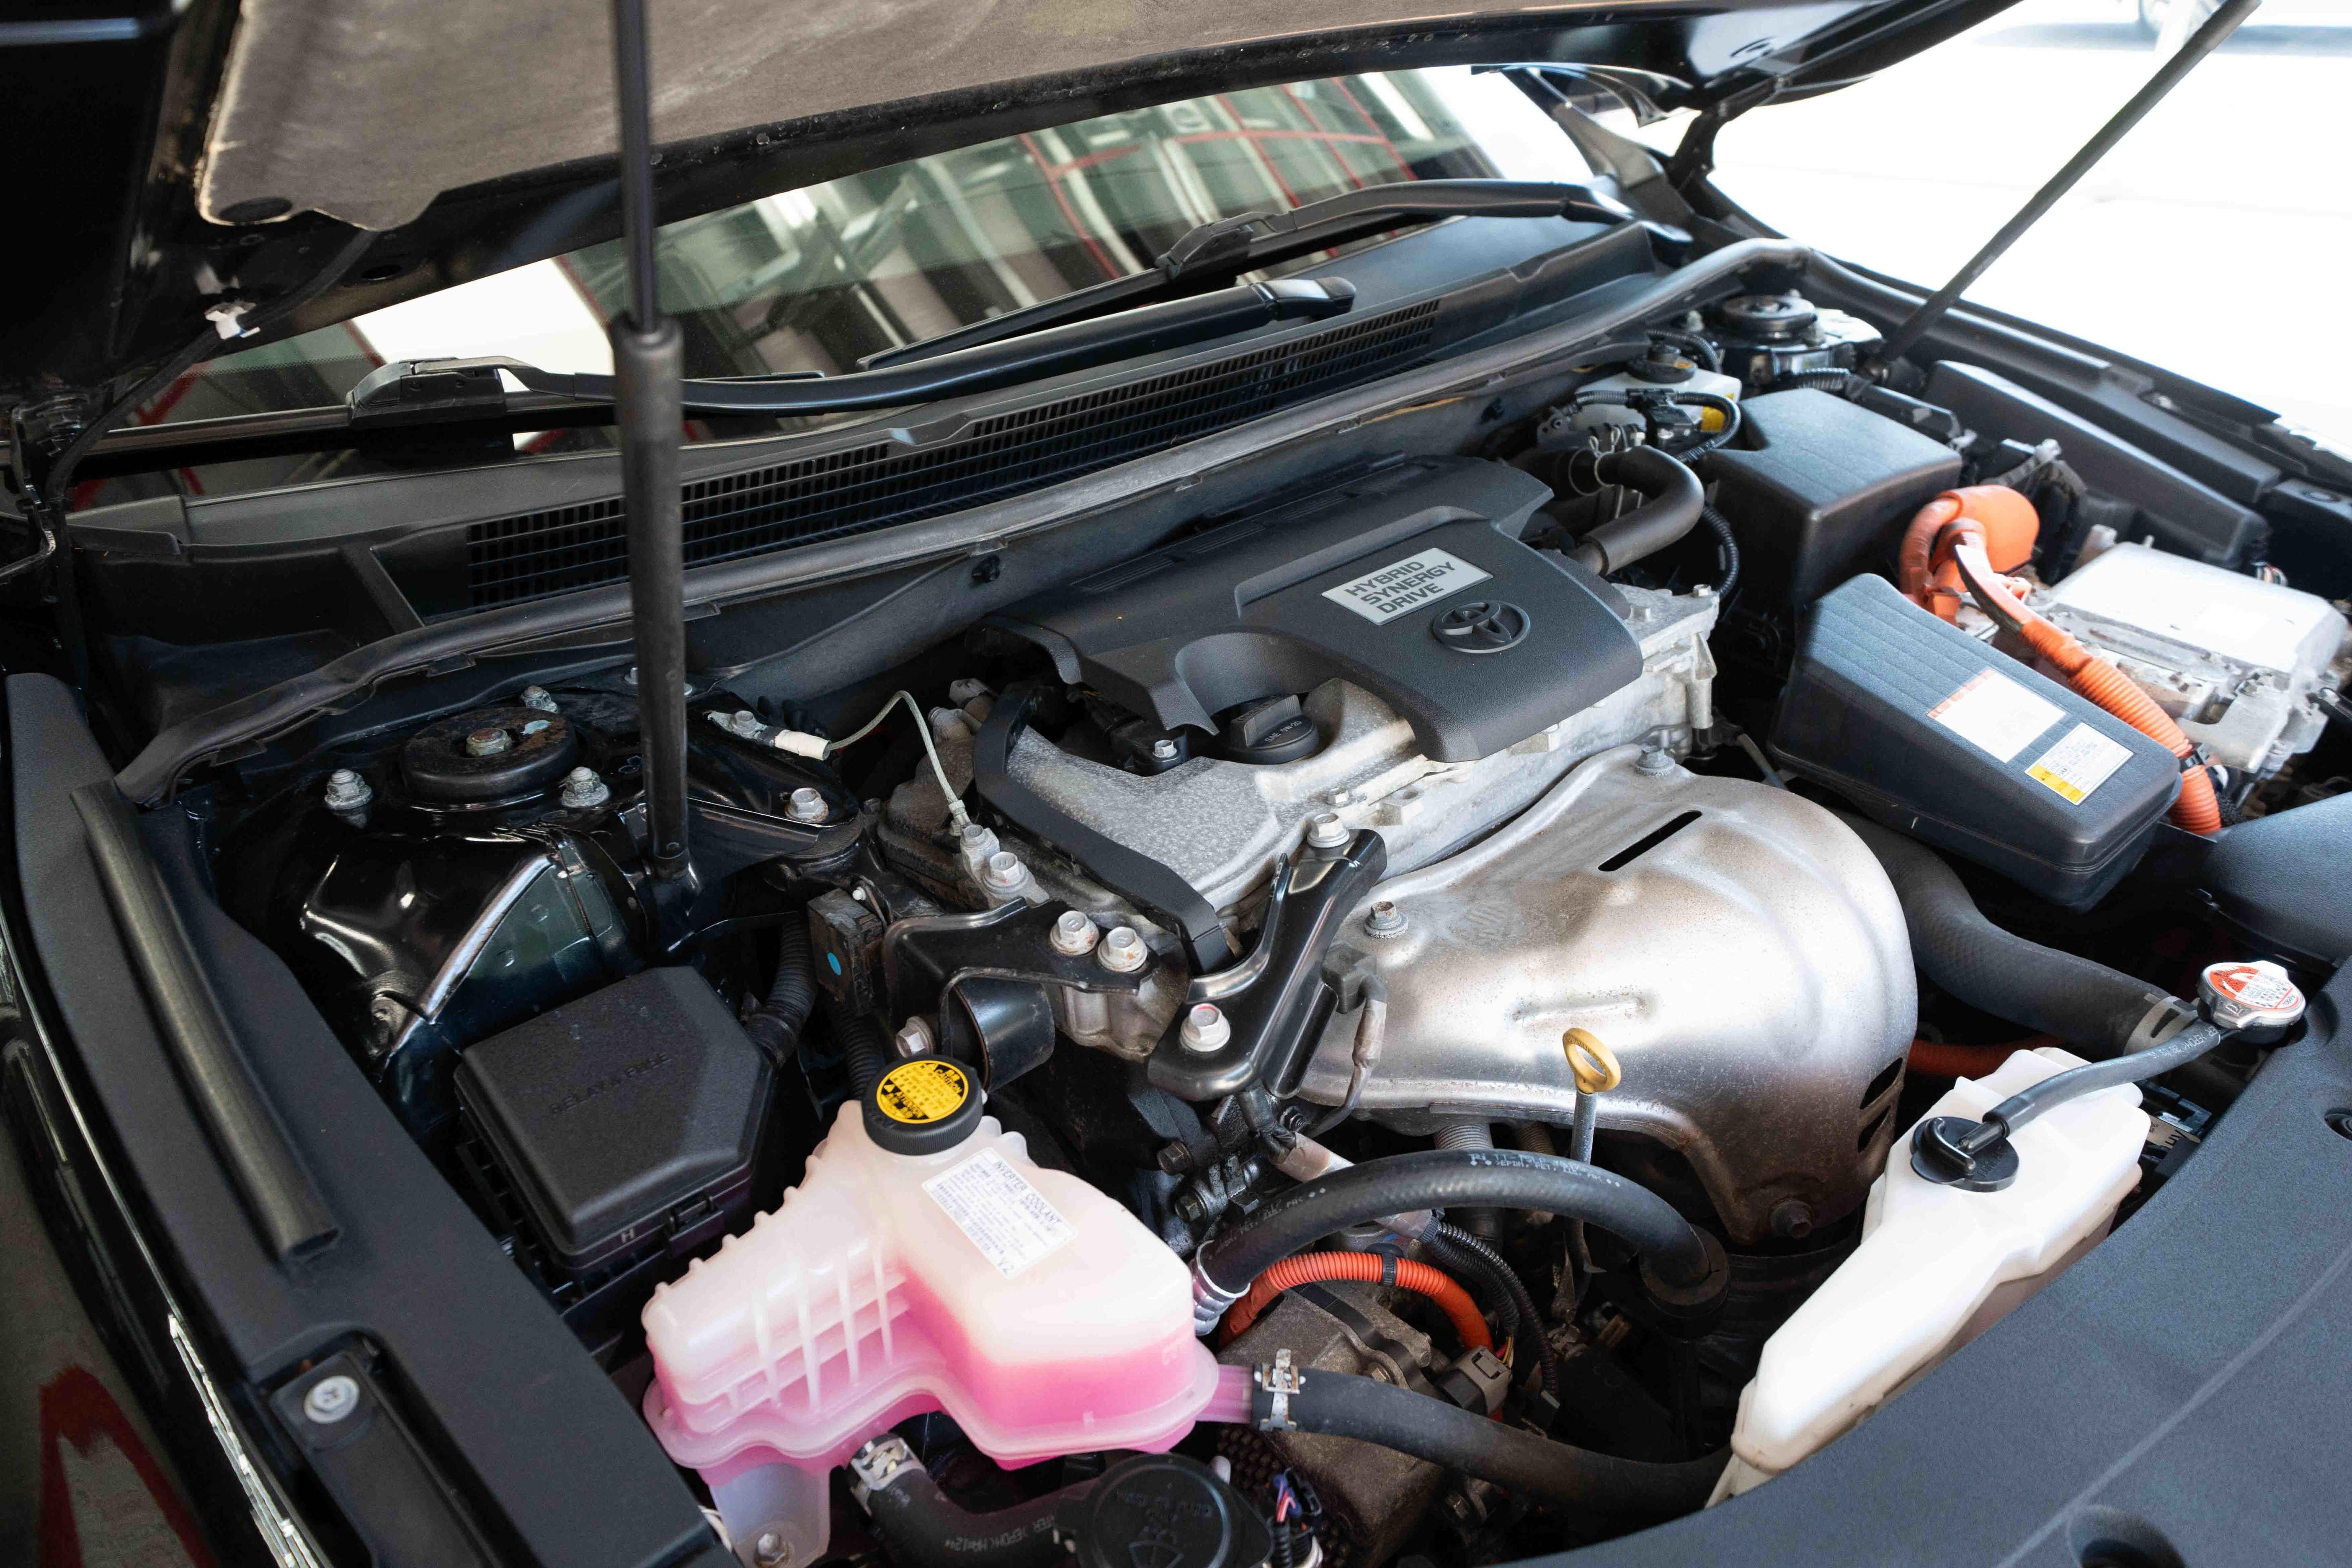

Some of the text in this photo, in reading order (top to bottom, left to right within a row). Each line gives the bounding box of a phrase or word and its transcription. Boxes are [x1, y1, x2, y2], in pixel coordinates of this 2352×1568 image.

[1344, 562, 1424, 597] HYBRID
[1361, 561, 1457, 604] SYNERGY
[1376, 583, 1444, 614] DRIVE
[1264, 720, 1303, 742] SAE 0W-20
